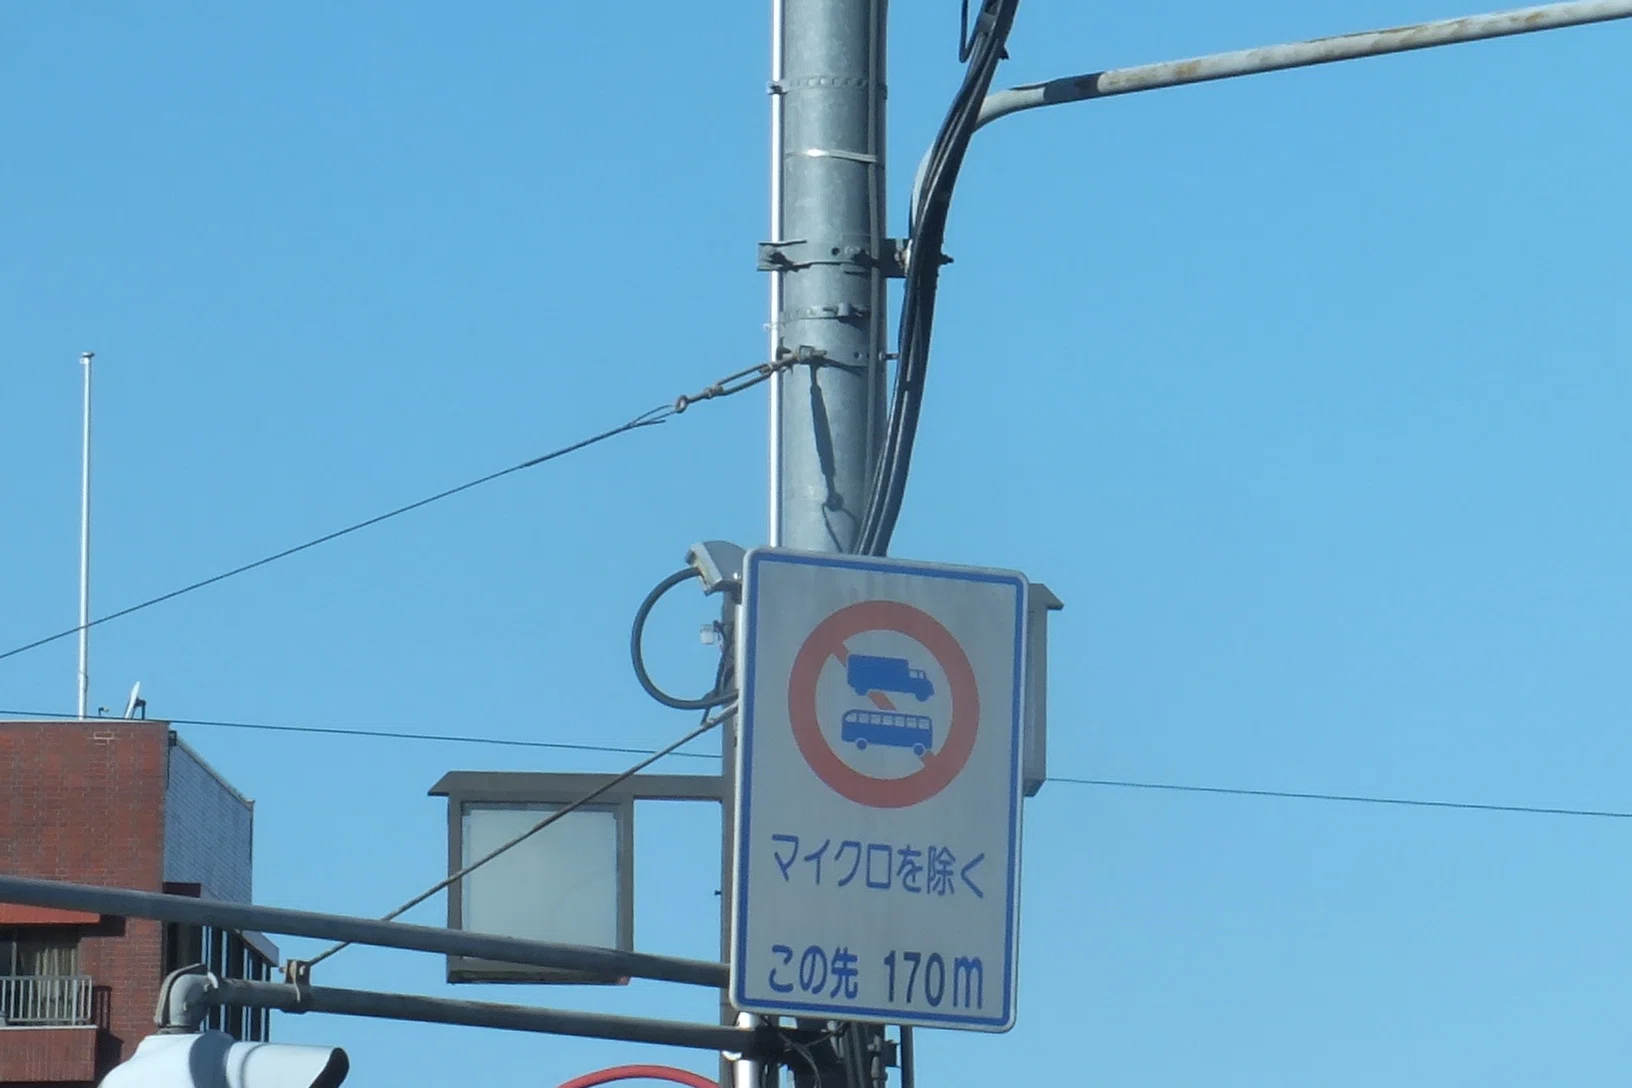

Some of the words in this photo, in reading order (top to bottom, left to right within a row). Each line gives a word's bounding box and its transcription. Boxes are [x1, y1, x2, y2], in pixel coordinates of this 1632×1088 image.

[771, 834, 986, 899] マイクロを除く
[768, 944, 858, 1000] この先
[883, 949, 984, 1009] 170m
